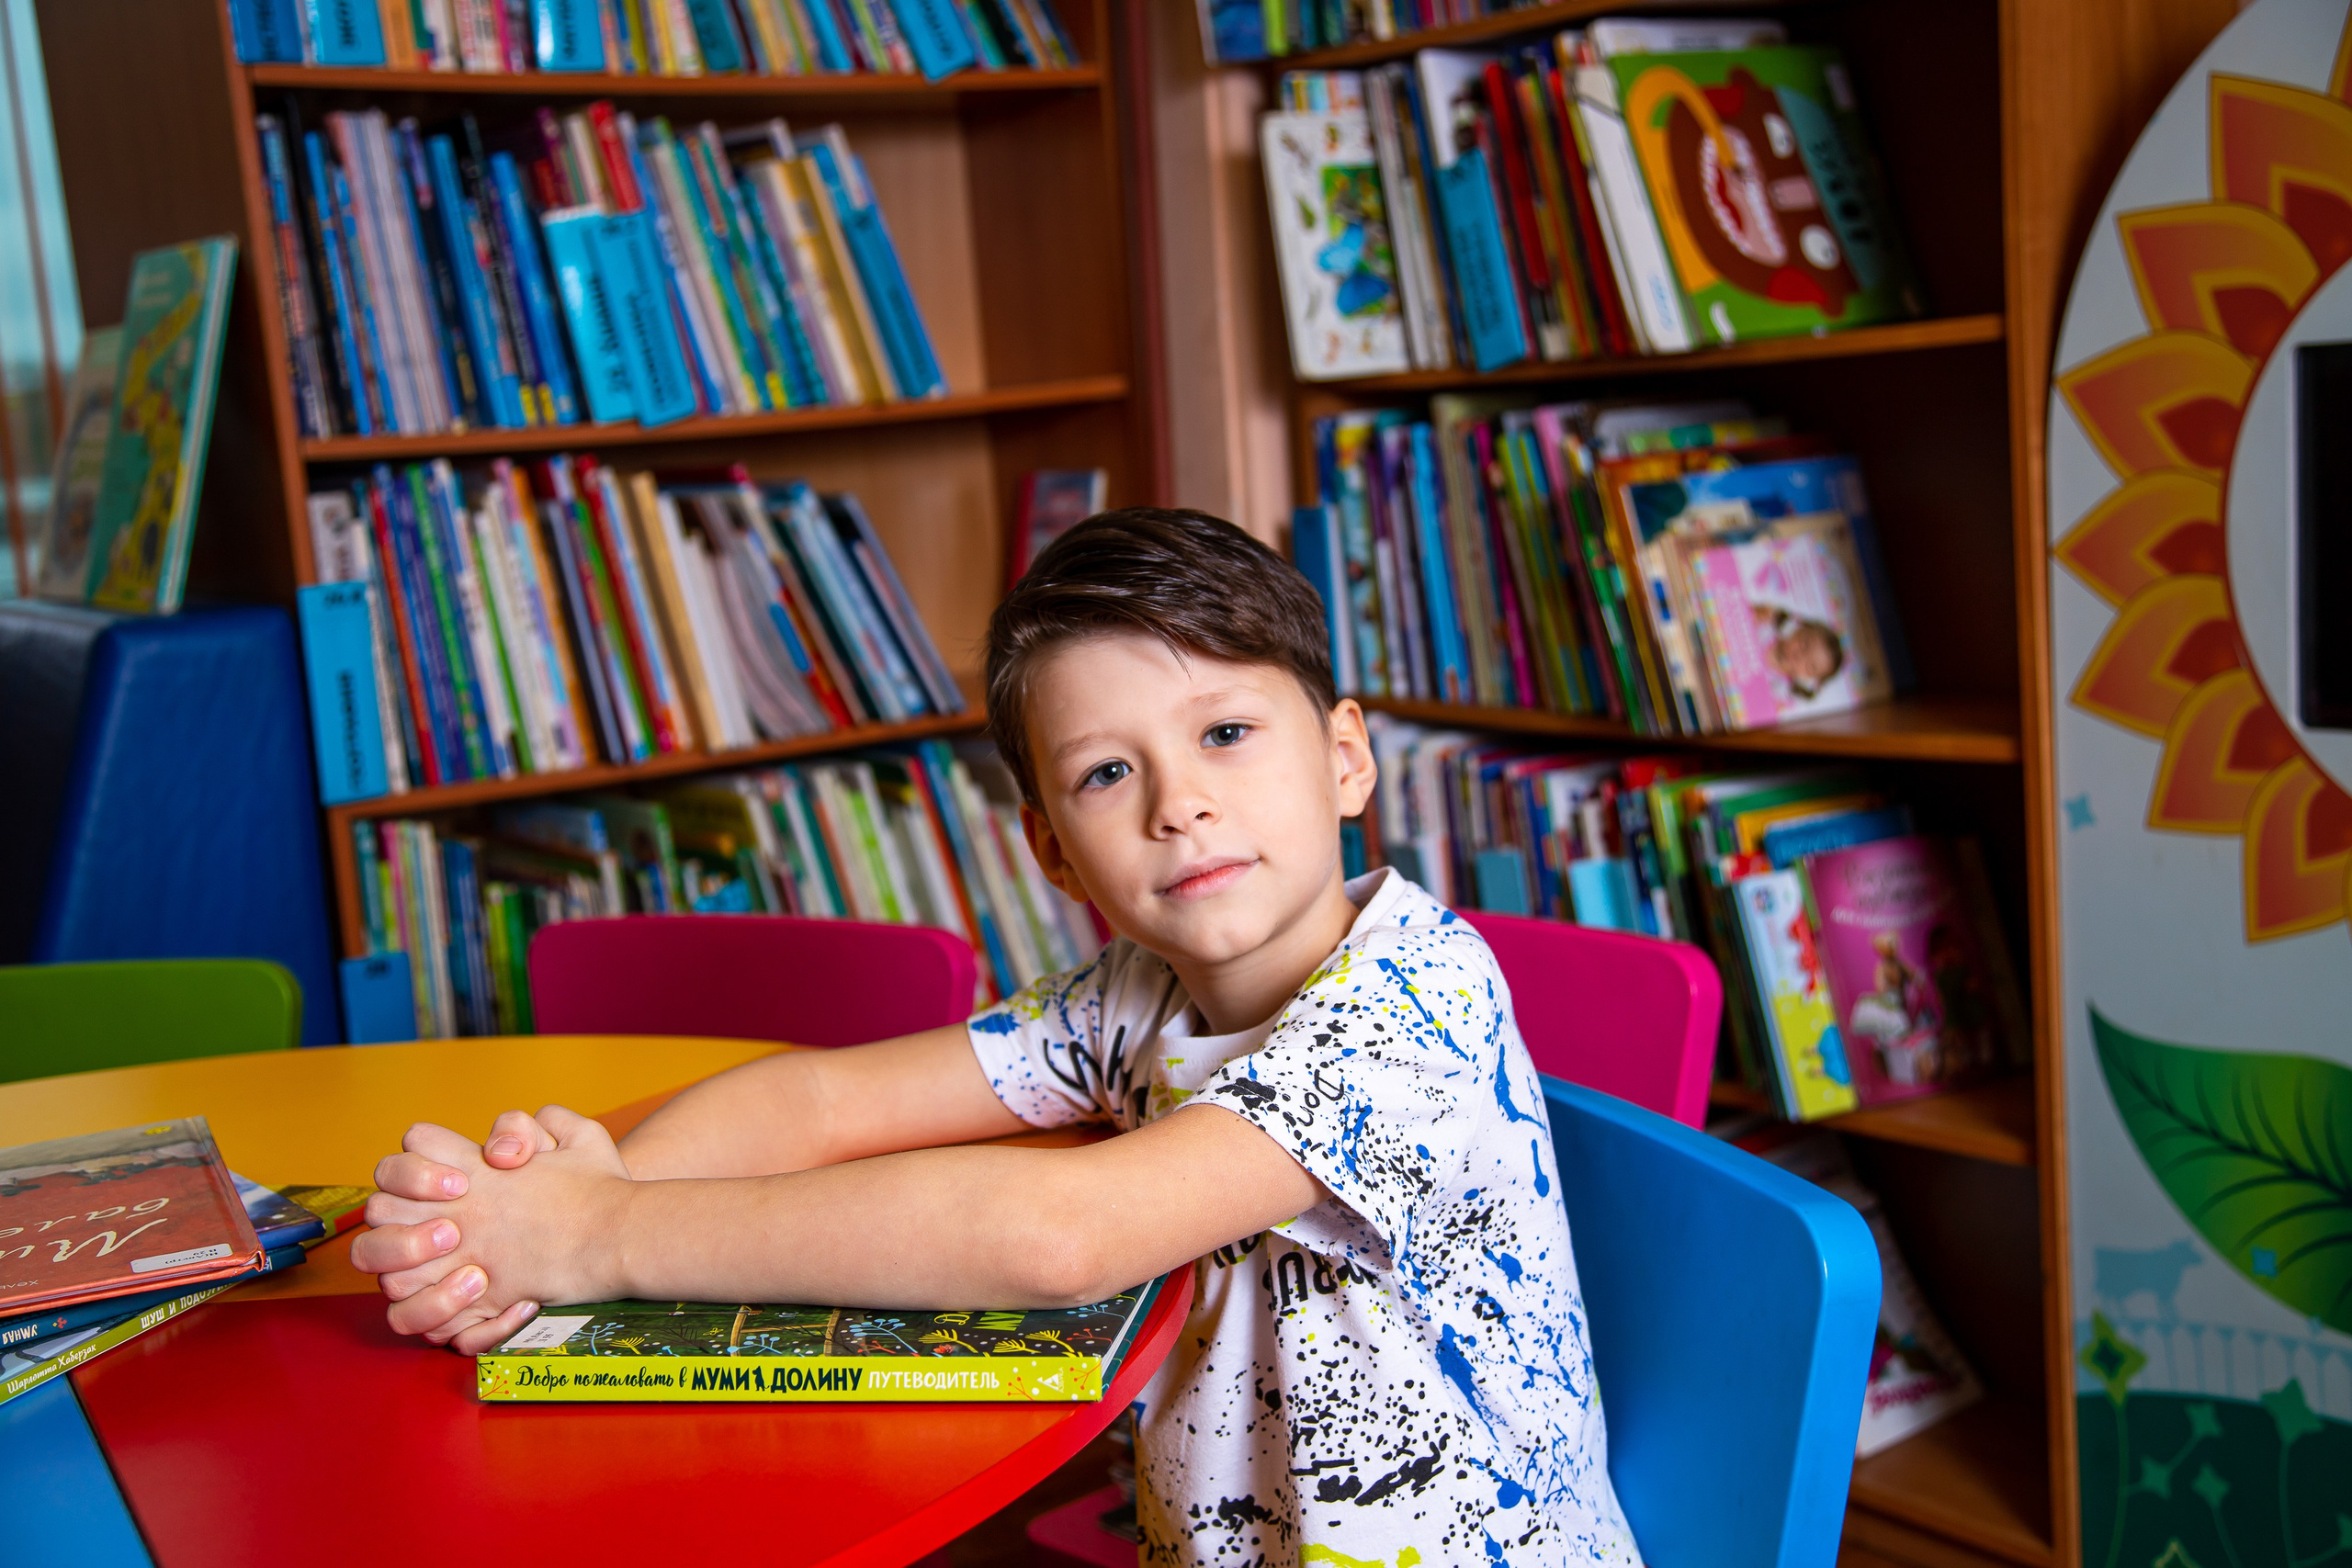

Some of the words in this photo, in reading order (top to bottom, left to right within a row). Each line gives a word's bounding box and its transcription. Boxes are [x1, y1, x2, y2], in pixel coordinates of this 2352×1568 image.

[141, 1307, 164, 1329] ШУШ
[168, 1302, 176, 1315] И
[2, 1324, 38, 1345] УМНАЯ
[6, 1365, 57, 1394] Шарлотта
[57, 1344, 96, 1370] Хаберзак
[514, 1364, 570, 1393] Добро
[573, 1366, 674, 1388] пожаловать
[679, 1366, 688, 1388] в
[691, 1366, 750, 1392] МУМИ
[770, 1367, 864, 1394] ДОЛИНУ
[867, 1371, 1001, 1390] ПУТЕВОДИТЕЛЬ
